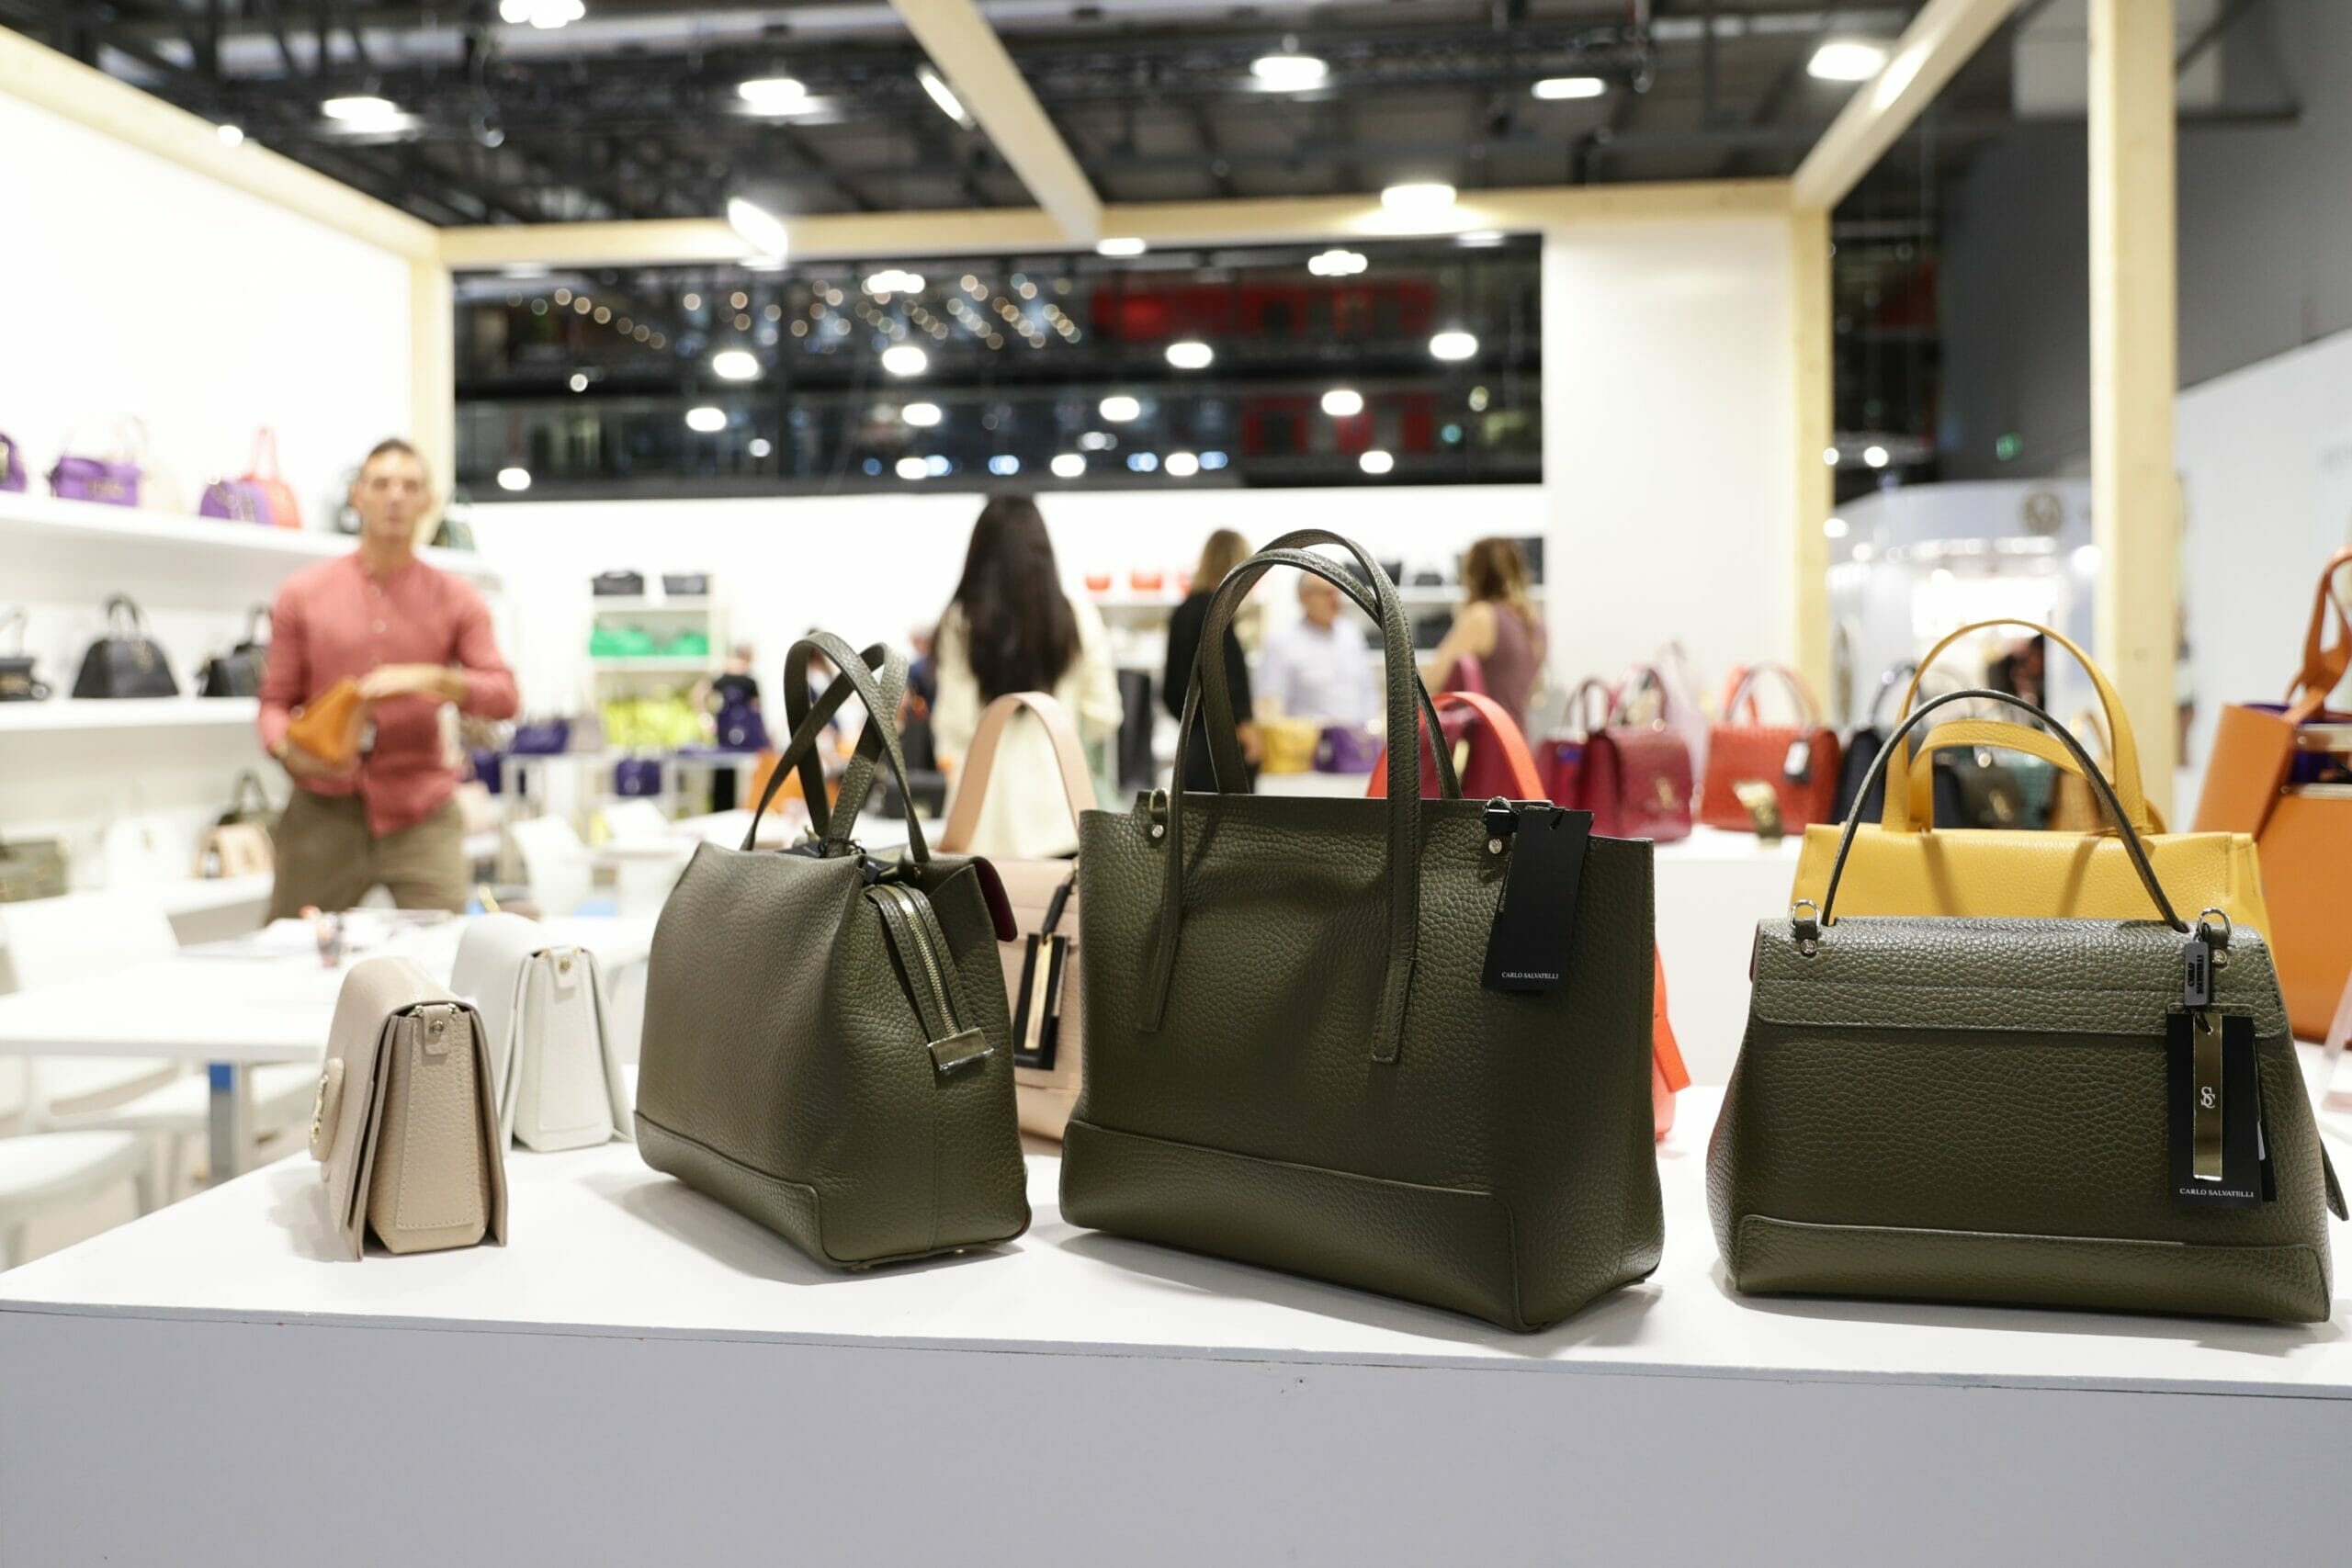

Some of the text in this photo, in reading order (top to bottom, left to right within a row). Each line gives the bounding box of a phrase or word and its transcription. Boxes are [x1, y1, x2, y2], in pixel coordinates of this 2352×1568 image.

[1523, 972, 1559, 980] SALVATELLI
[2179, 1188, 2255, 1198] CARLO SALVATELLI
